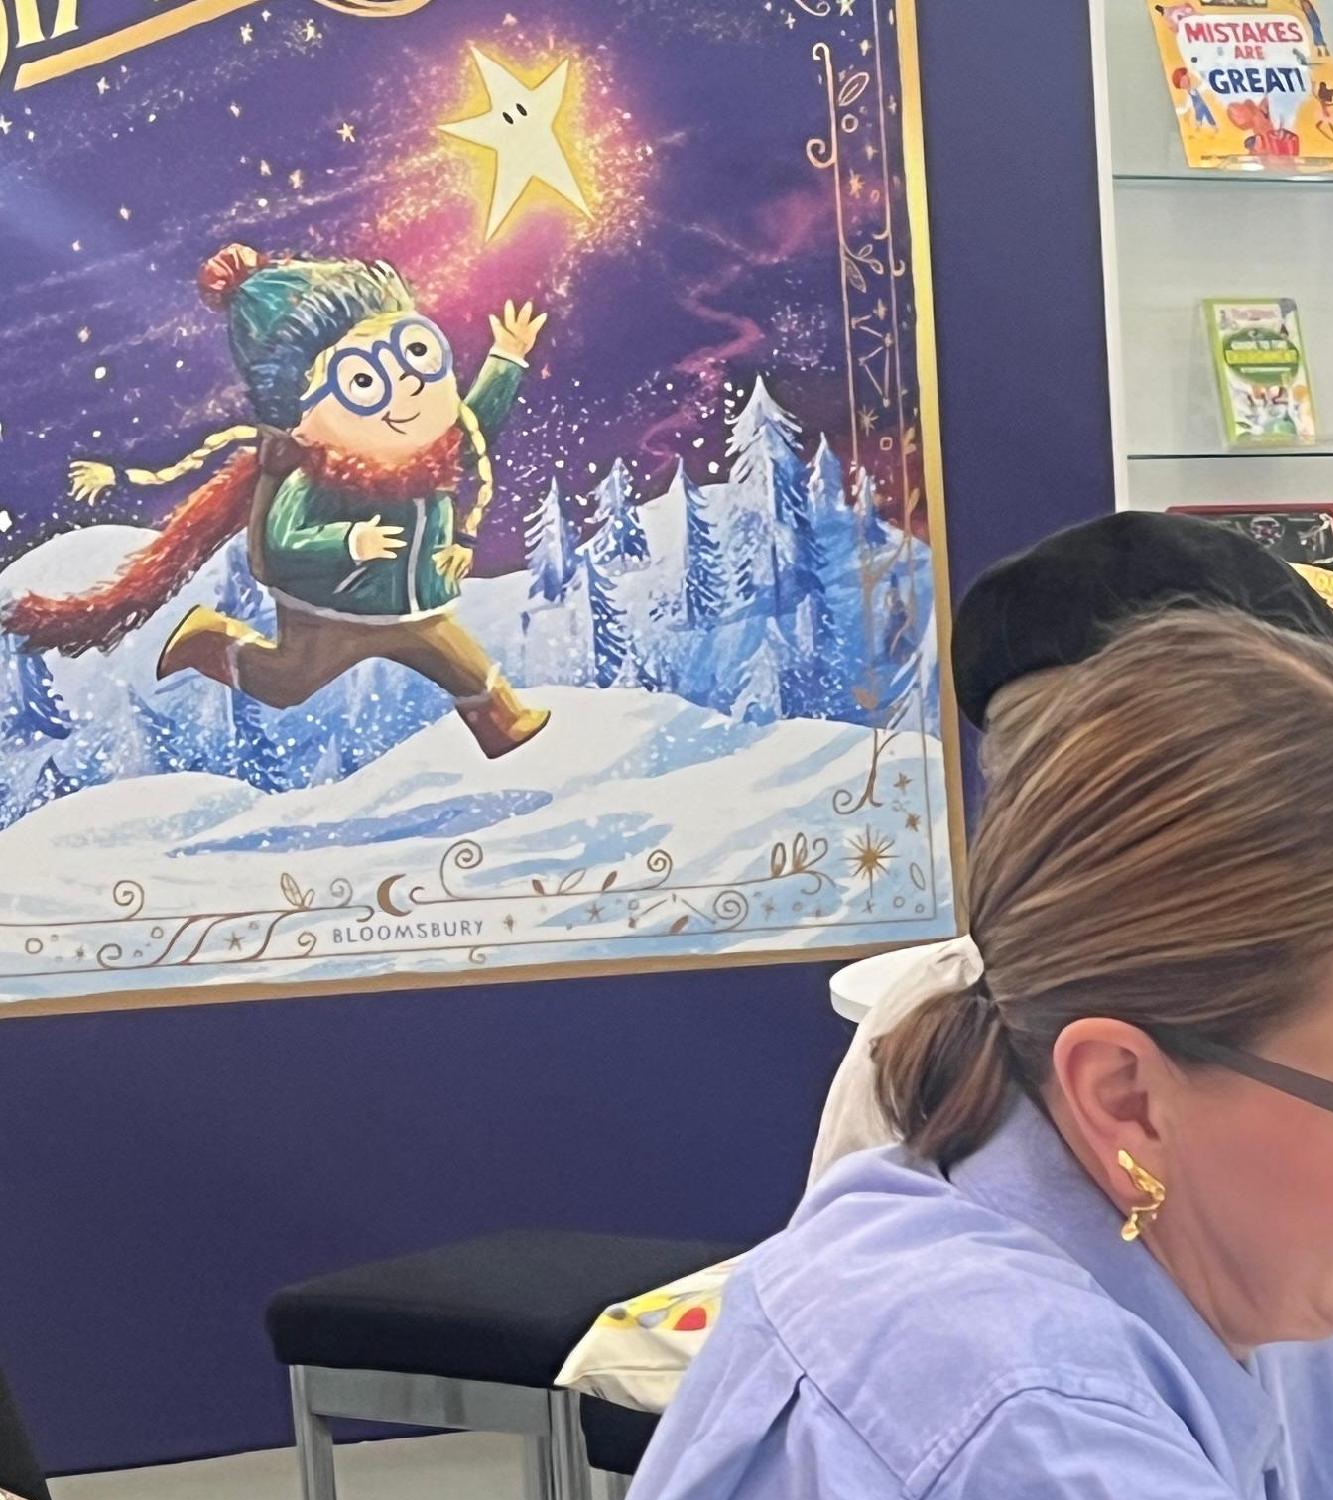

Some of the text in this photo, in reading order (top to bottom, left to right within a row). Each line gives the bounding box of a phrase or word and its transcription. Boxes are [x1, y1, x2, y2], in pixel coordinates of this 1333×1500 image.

[1184, 22, 1304, 43] MISTAKES
[1234, 45, 1266, 60] ARE
[1208, 67, 1306, 94] GREAT!
[333, 920, 484, 944] BLOOMSBURY
